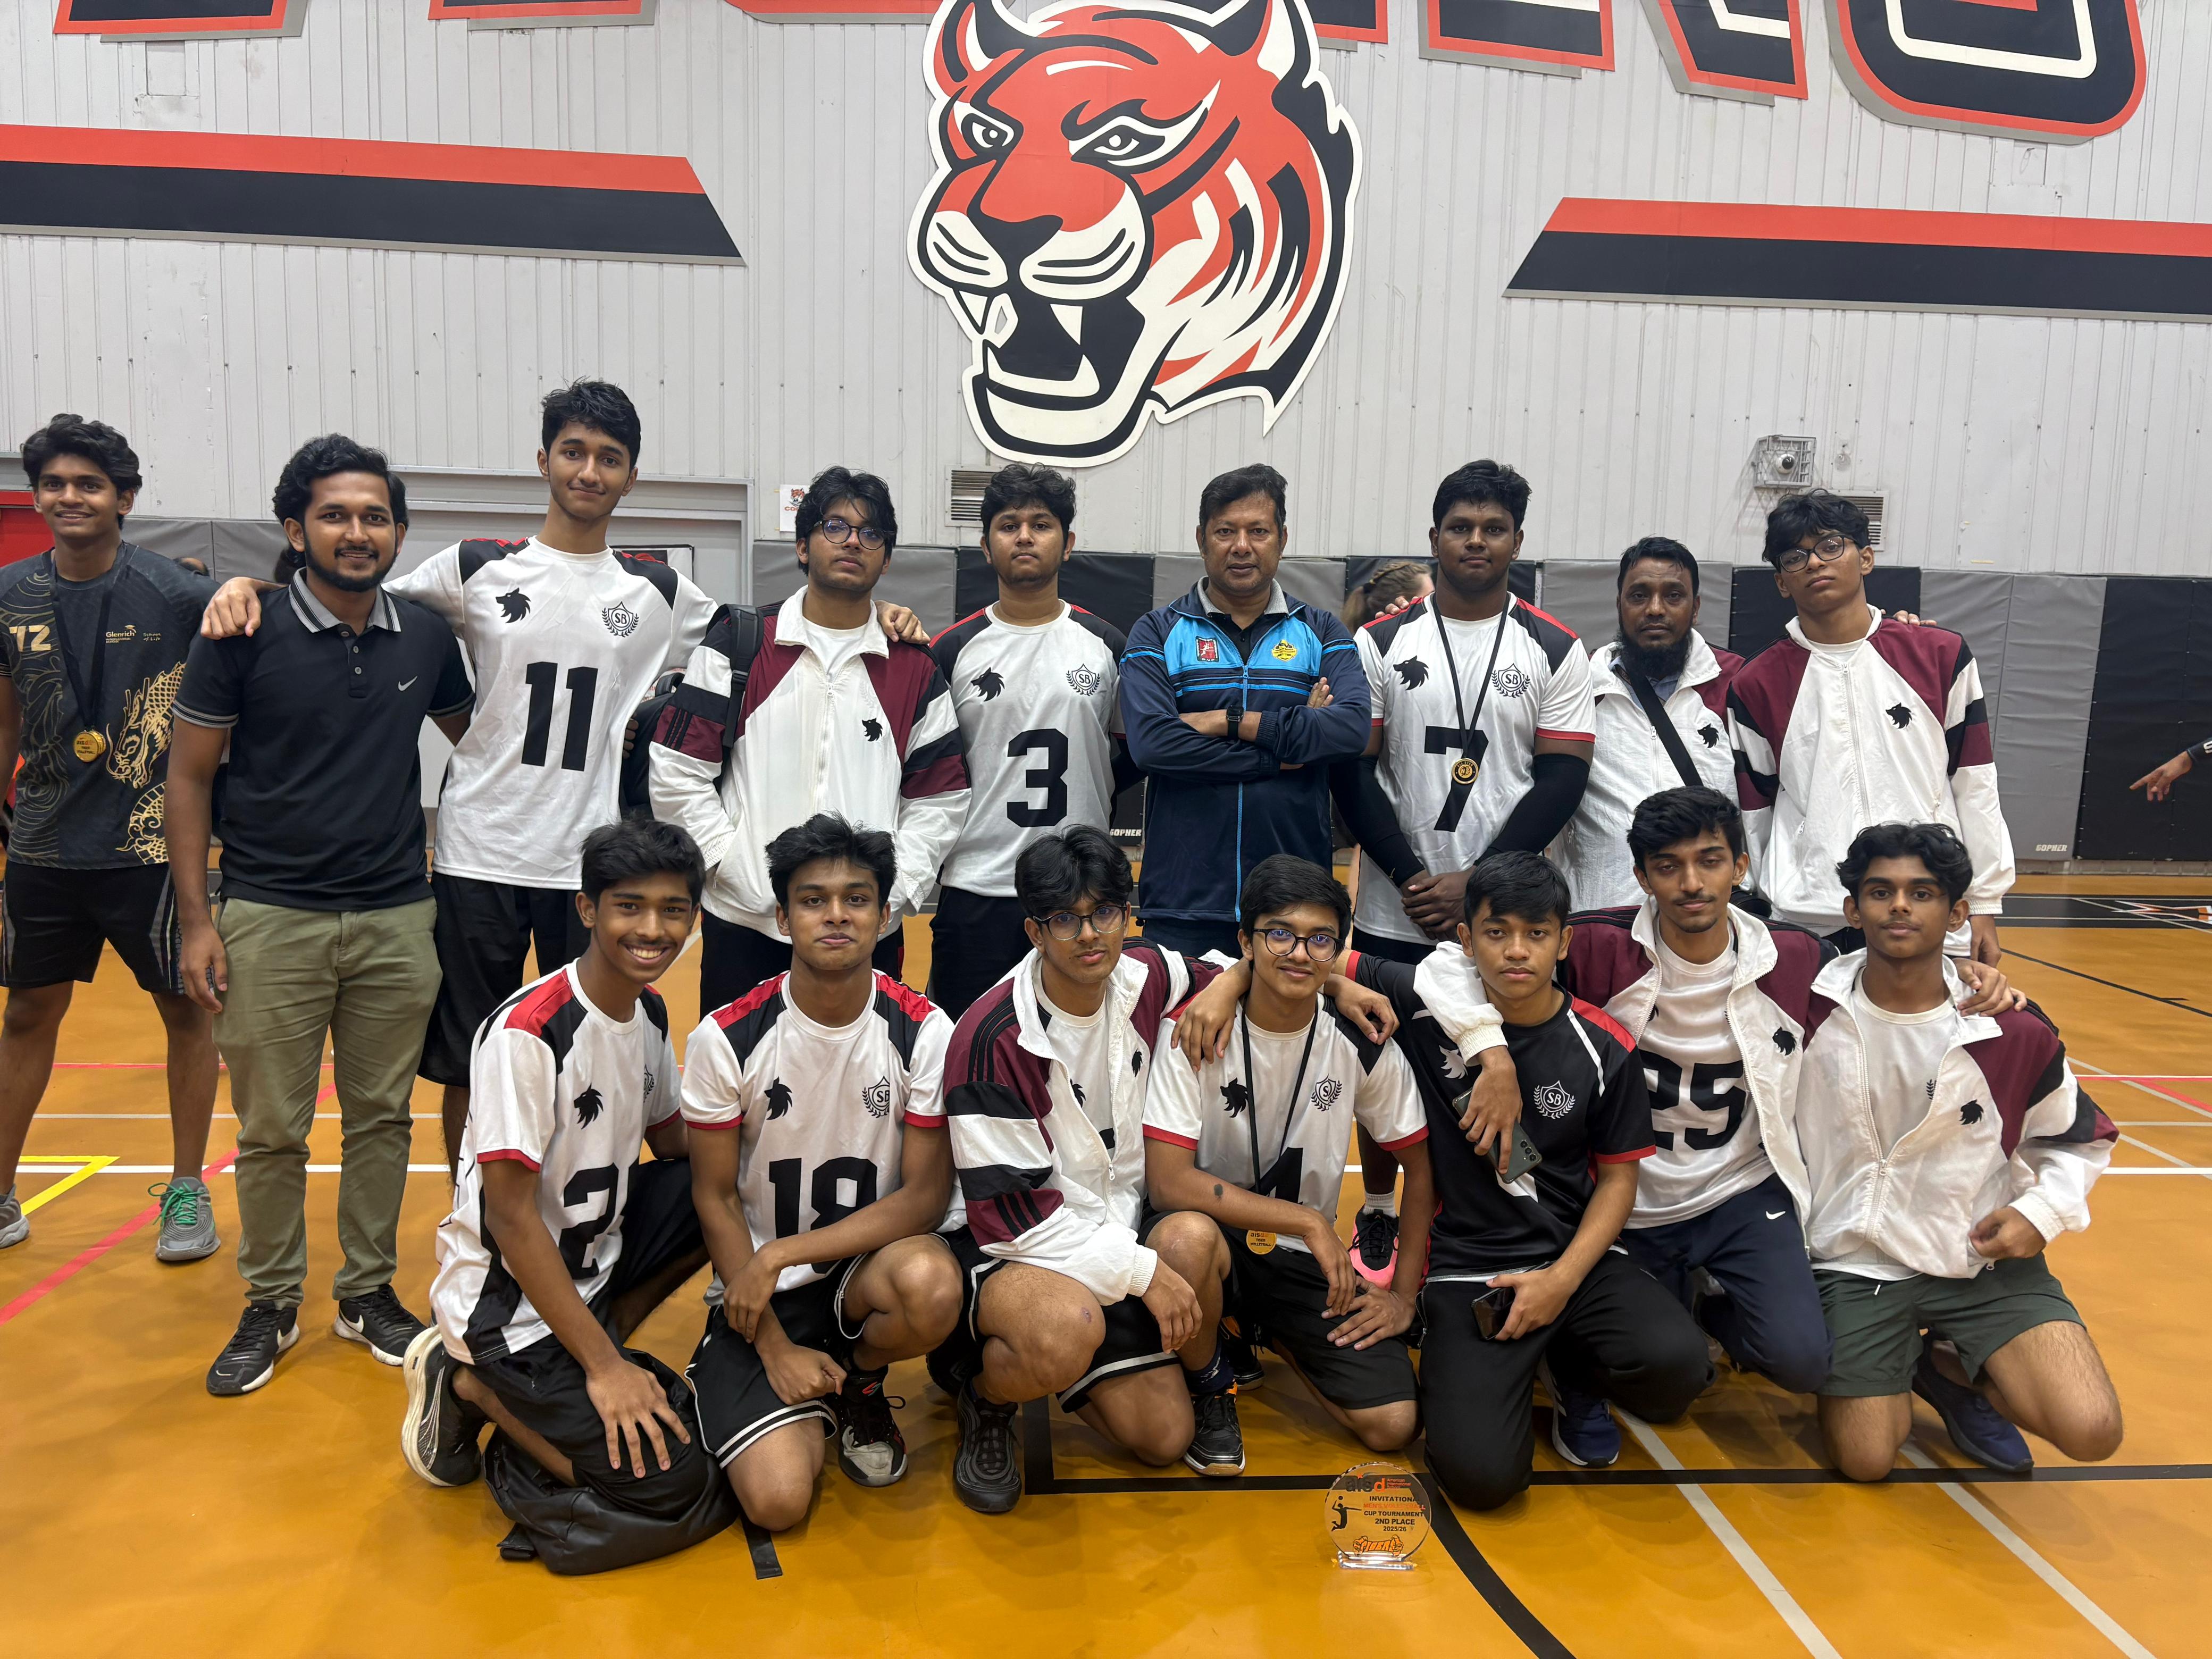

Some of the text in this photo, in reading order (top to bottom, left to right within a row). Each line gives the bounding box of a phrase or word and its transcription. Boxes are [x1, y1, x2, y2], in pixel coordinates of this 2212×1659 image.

[9, 625, 51, 652] 72
[615, 613, 627, 624] SB
[1079, 673, 1091, 685] SB
[1505, 673, 1518, 685] SB
[521, 661, 599, 772] 11
[1007, 728, 1068, 828] 3
[1424, 725, 1489, 832] 7
[1546, 1091, 1562, 1105] SB
[1639, 1049, 1747, 1151] 25
[769, 1157, 878, 1275] 18
